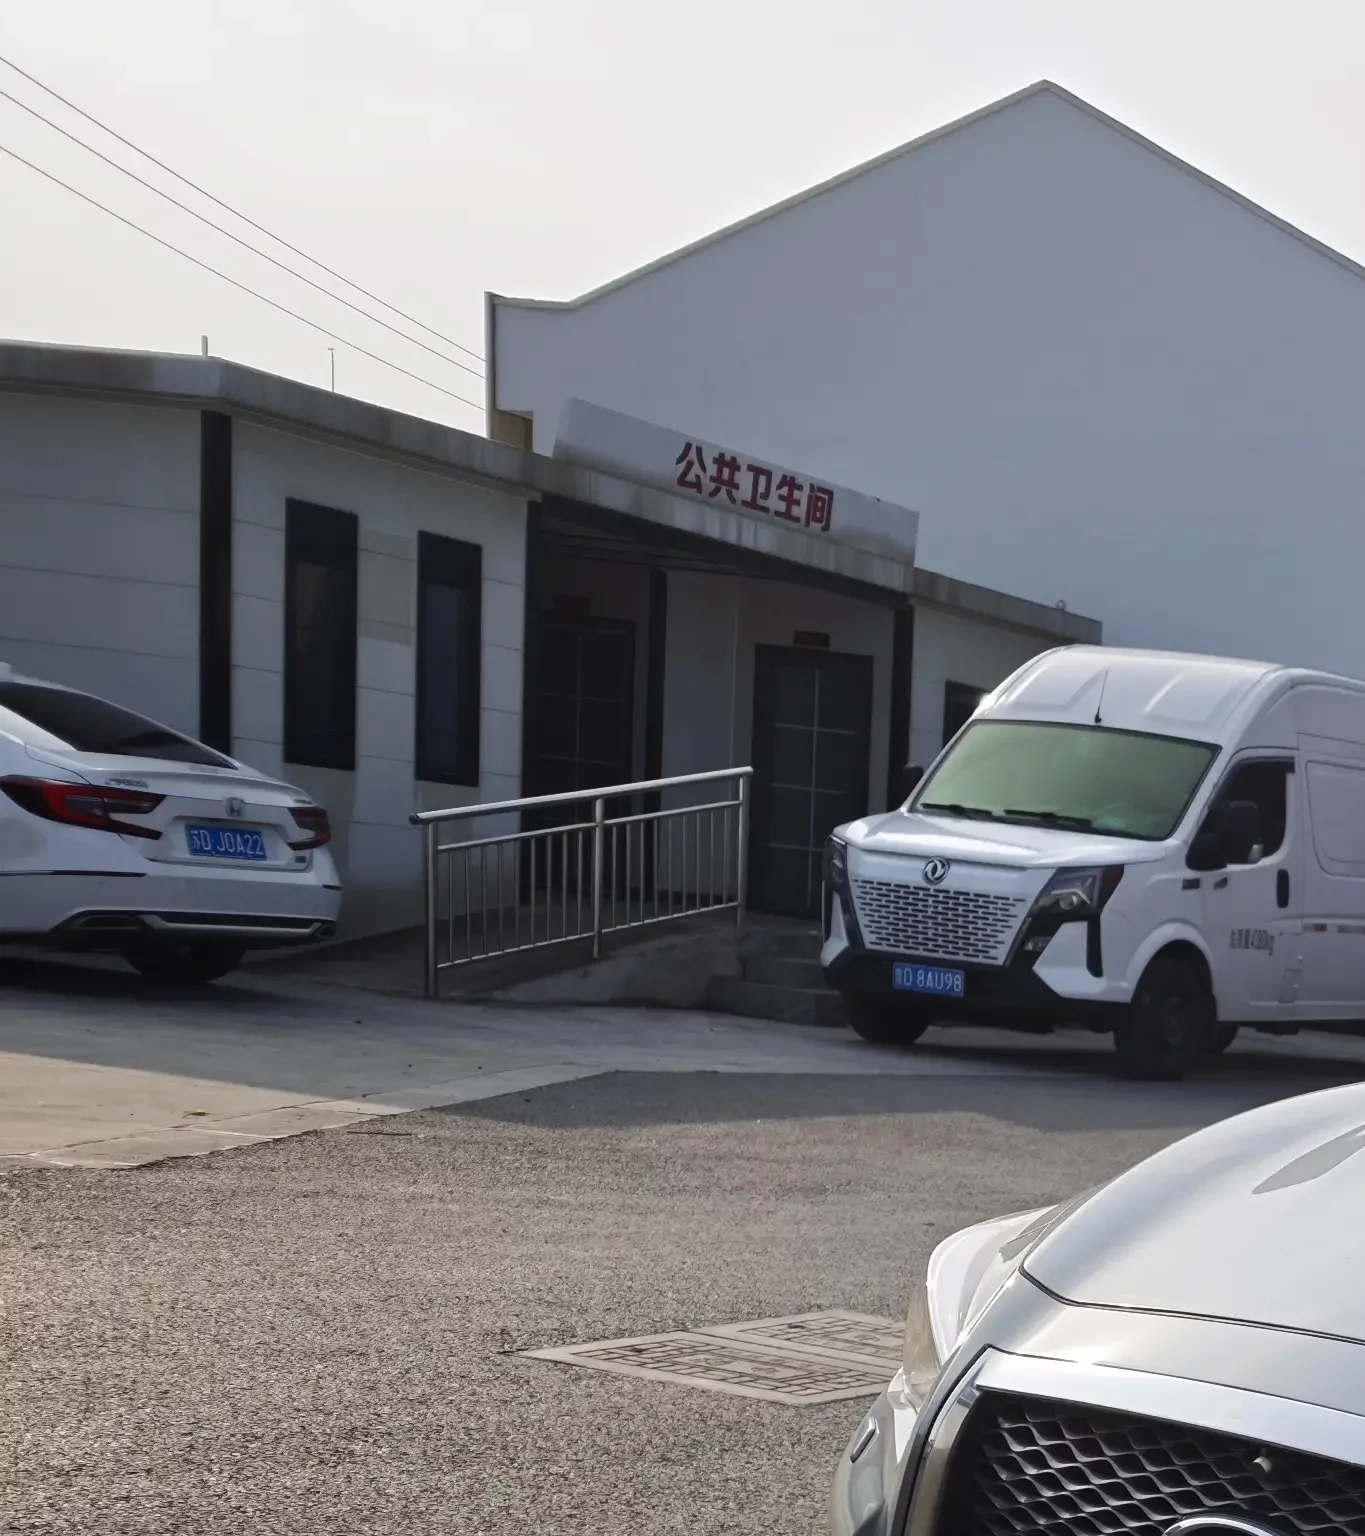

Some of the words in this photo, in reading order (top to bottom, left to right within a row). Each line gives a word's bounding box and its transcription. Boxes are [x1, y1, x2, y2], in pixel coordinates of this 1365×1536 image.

[676, 442, 834, 532] 公共卫生间
